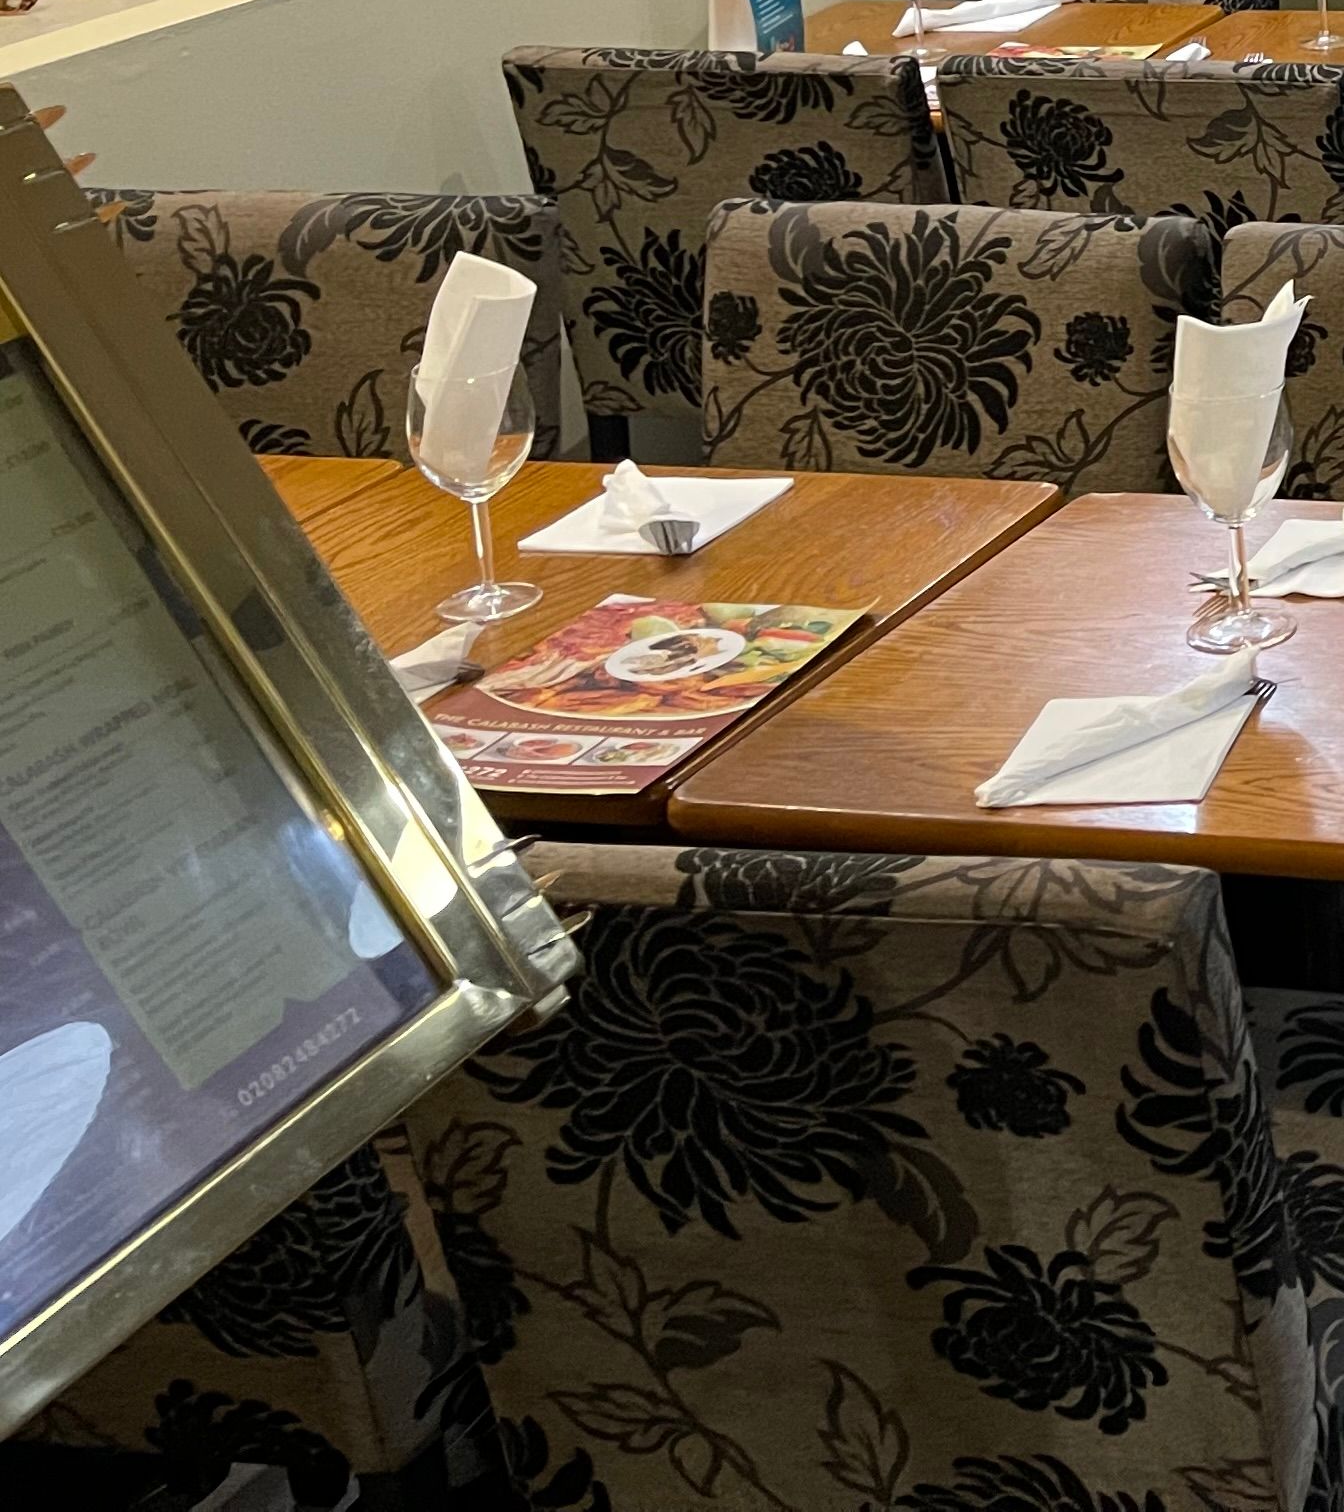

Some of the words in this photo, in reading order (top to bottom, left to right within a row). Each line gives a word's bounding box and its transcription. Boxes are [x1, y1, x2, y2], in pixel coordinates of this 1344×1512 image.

[434, 713, 467, 724] THE
[467, 719, 551, 730] CALABASH
[552, 723, 658, 736] RESTAURANT
